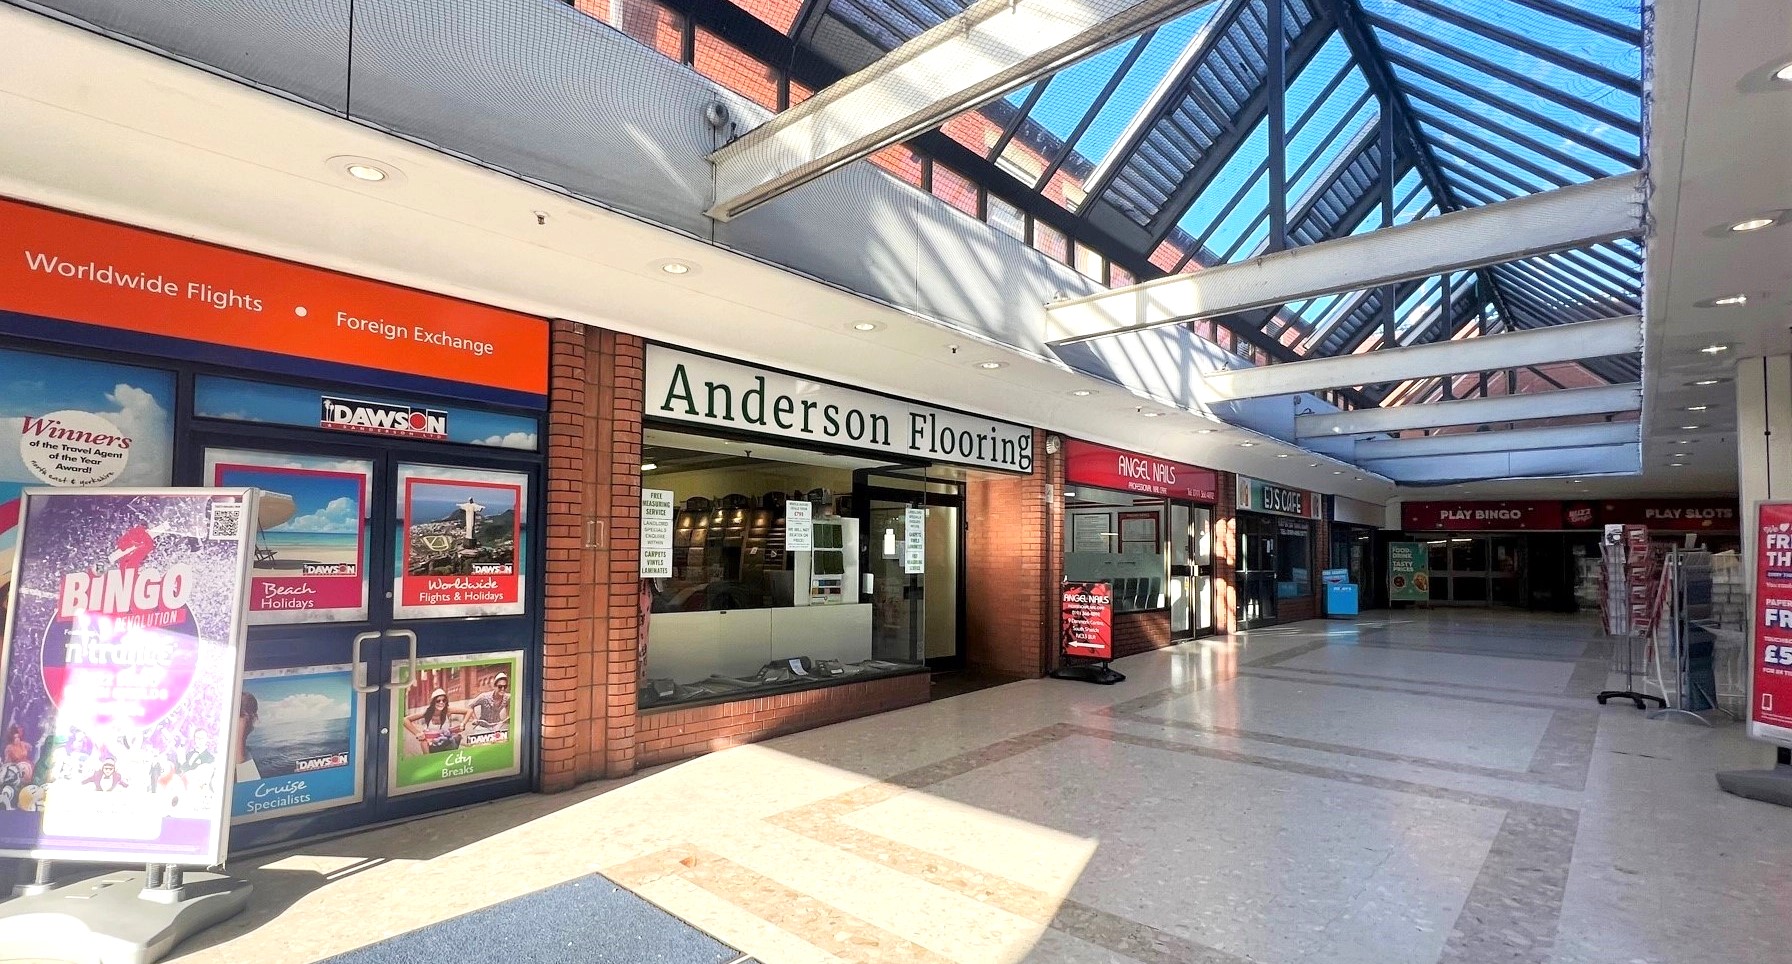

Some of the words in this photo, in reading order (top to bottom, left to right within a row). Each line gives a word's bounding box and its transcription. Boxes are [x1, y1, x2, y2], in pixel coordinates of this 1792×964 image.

[25, 250, 179, 296] Worldwide
[187, 282, 264, 312] Flights
[336, 311, 408, 340] Foreign
[413, 326, 494, 356] Exchange
[333, 404, 446, 434] DAWSON
[660, 363, 890, 446] Anderson
[908, 411, 1032, 470] Flooring
[22, 415, 132, 449] Winners
[42, 441, 59, 450] the
[61, 444, 92, 455] Travel
[93, 448, 122, 459] Agent
[48, 452, 59, 460] of
[61, 454, 77, 462] the
[80, 457, 102, 466] Year
[55, 463, 92, 474] Award!
[1119, 455, 1151, 481] ANGEL
[1153, 462, 1176, 484] NAILS
[643, 500, 670, 508] MEASURING
[1281, 490, 1301, 513] CAFE
[646, 508, 666, 516] SERVICE
[1441, 510, 1472, 520] PLAY
[1475, 509, 1521, 520] BINGO
[1645, 508, 1682, 519] PLAY
[1685, 508, 1732, 519] SLOTS
[1766, 534, 1792, 549] FR
[307, 563, 355, 575] DAWSON
[475, 564, 513, 575] DAWSON
[263, 583, 316, 598] Beach
[428, 579, 499, 591] Worldwide
[261, 597, 314, 610] Holidays
[419, 592, 451, 604] Flights
[453, 592, 461, 601] &
[465, 591, 504, 604] Holidays
[1063, 594, 1088, 603] ANGEL
[1088, 595, 1109, 604] NAILS
[470, 731, 508, 744] DAWSON
[300, 754, 348, 770] DAWSON
[445, 750, 471, 766] City
[442, 765, 474, 778] Breaks
[255, 779, 307, 798] Cruise
[247, 795, 311, 813] Specialists
